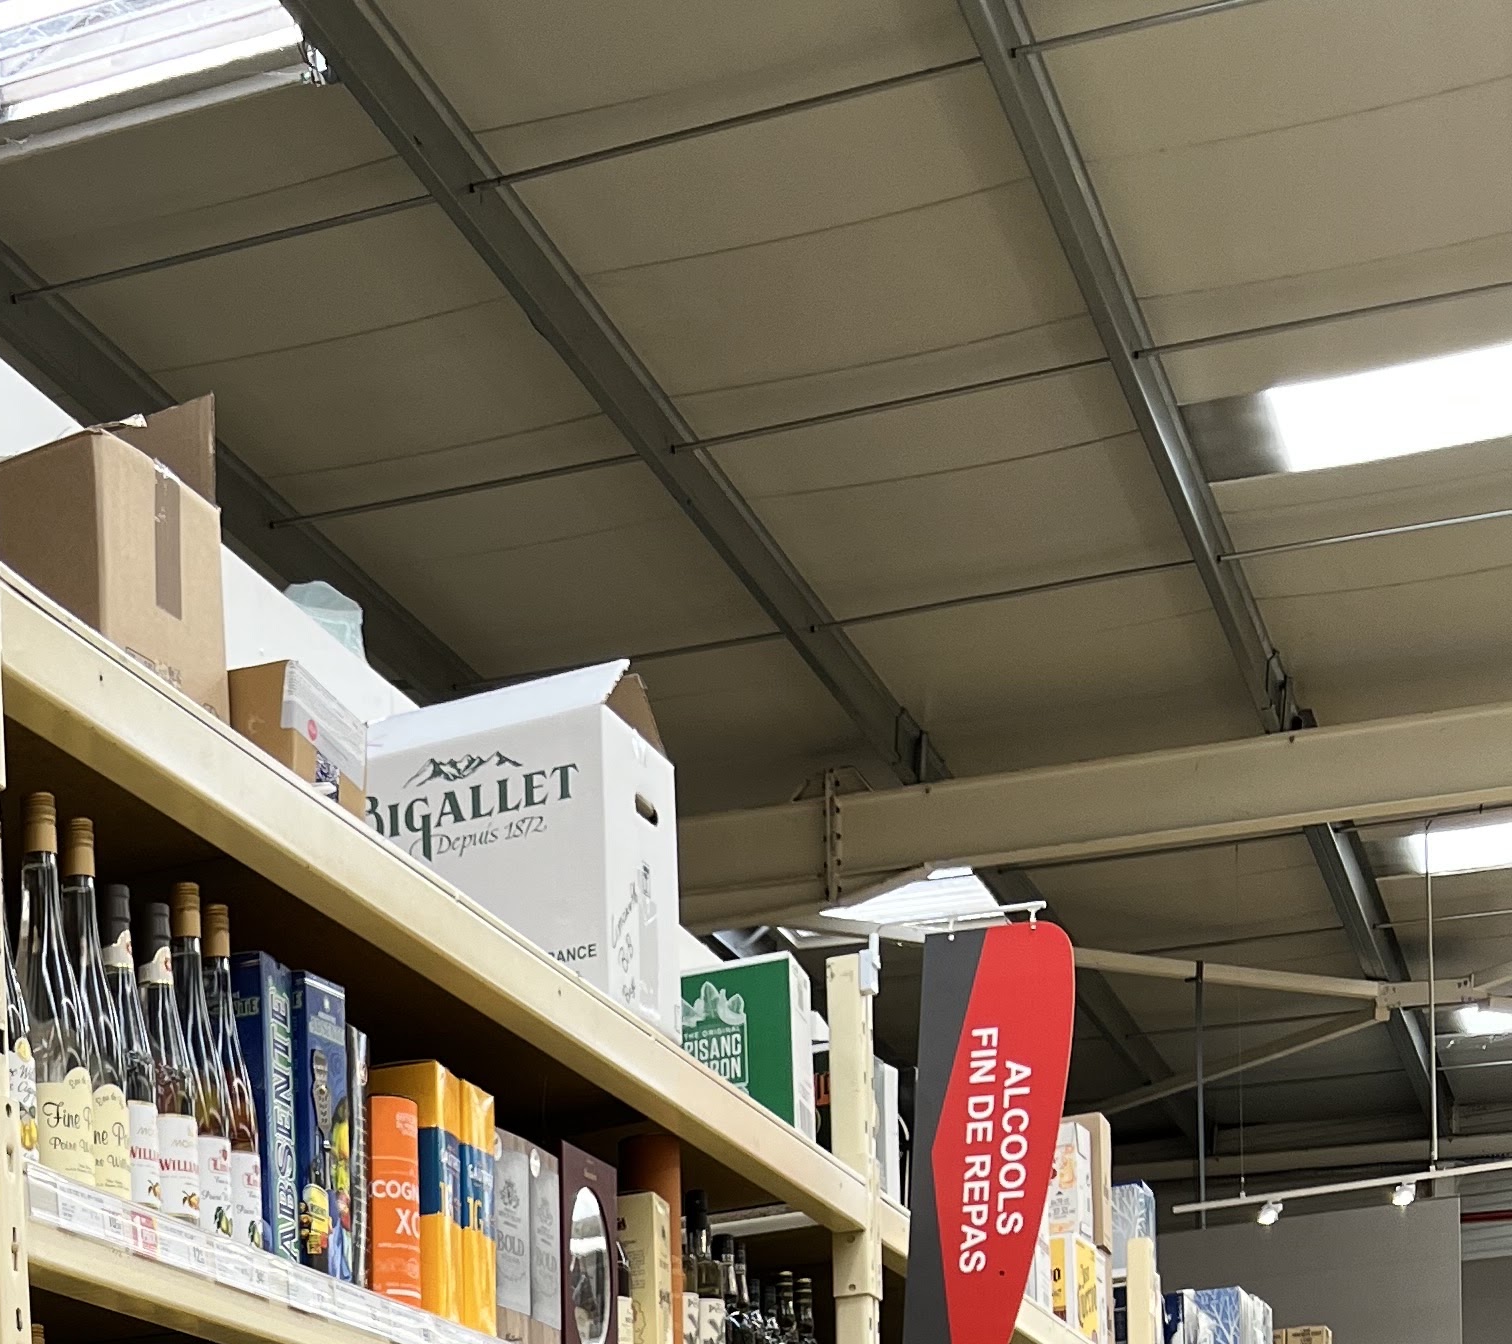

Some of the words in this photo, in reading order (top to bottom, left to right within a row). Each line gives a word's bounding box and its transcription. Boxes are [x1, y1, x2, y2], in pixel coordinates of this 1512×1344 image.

[970, 1026, 999, 1086] FIN
[965, 1094, 993, 1144] DE
[994, 1059, 1032, 1236] ALCOOLS
[959, 1156, 992, 1275] REPAS
